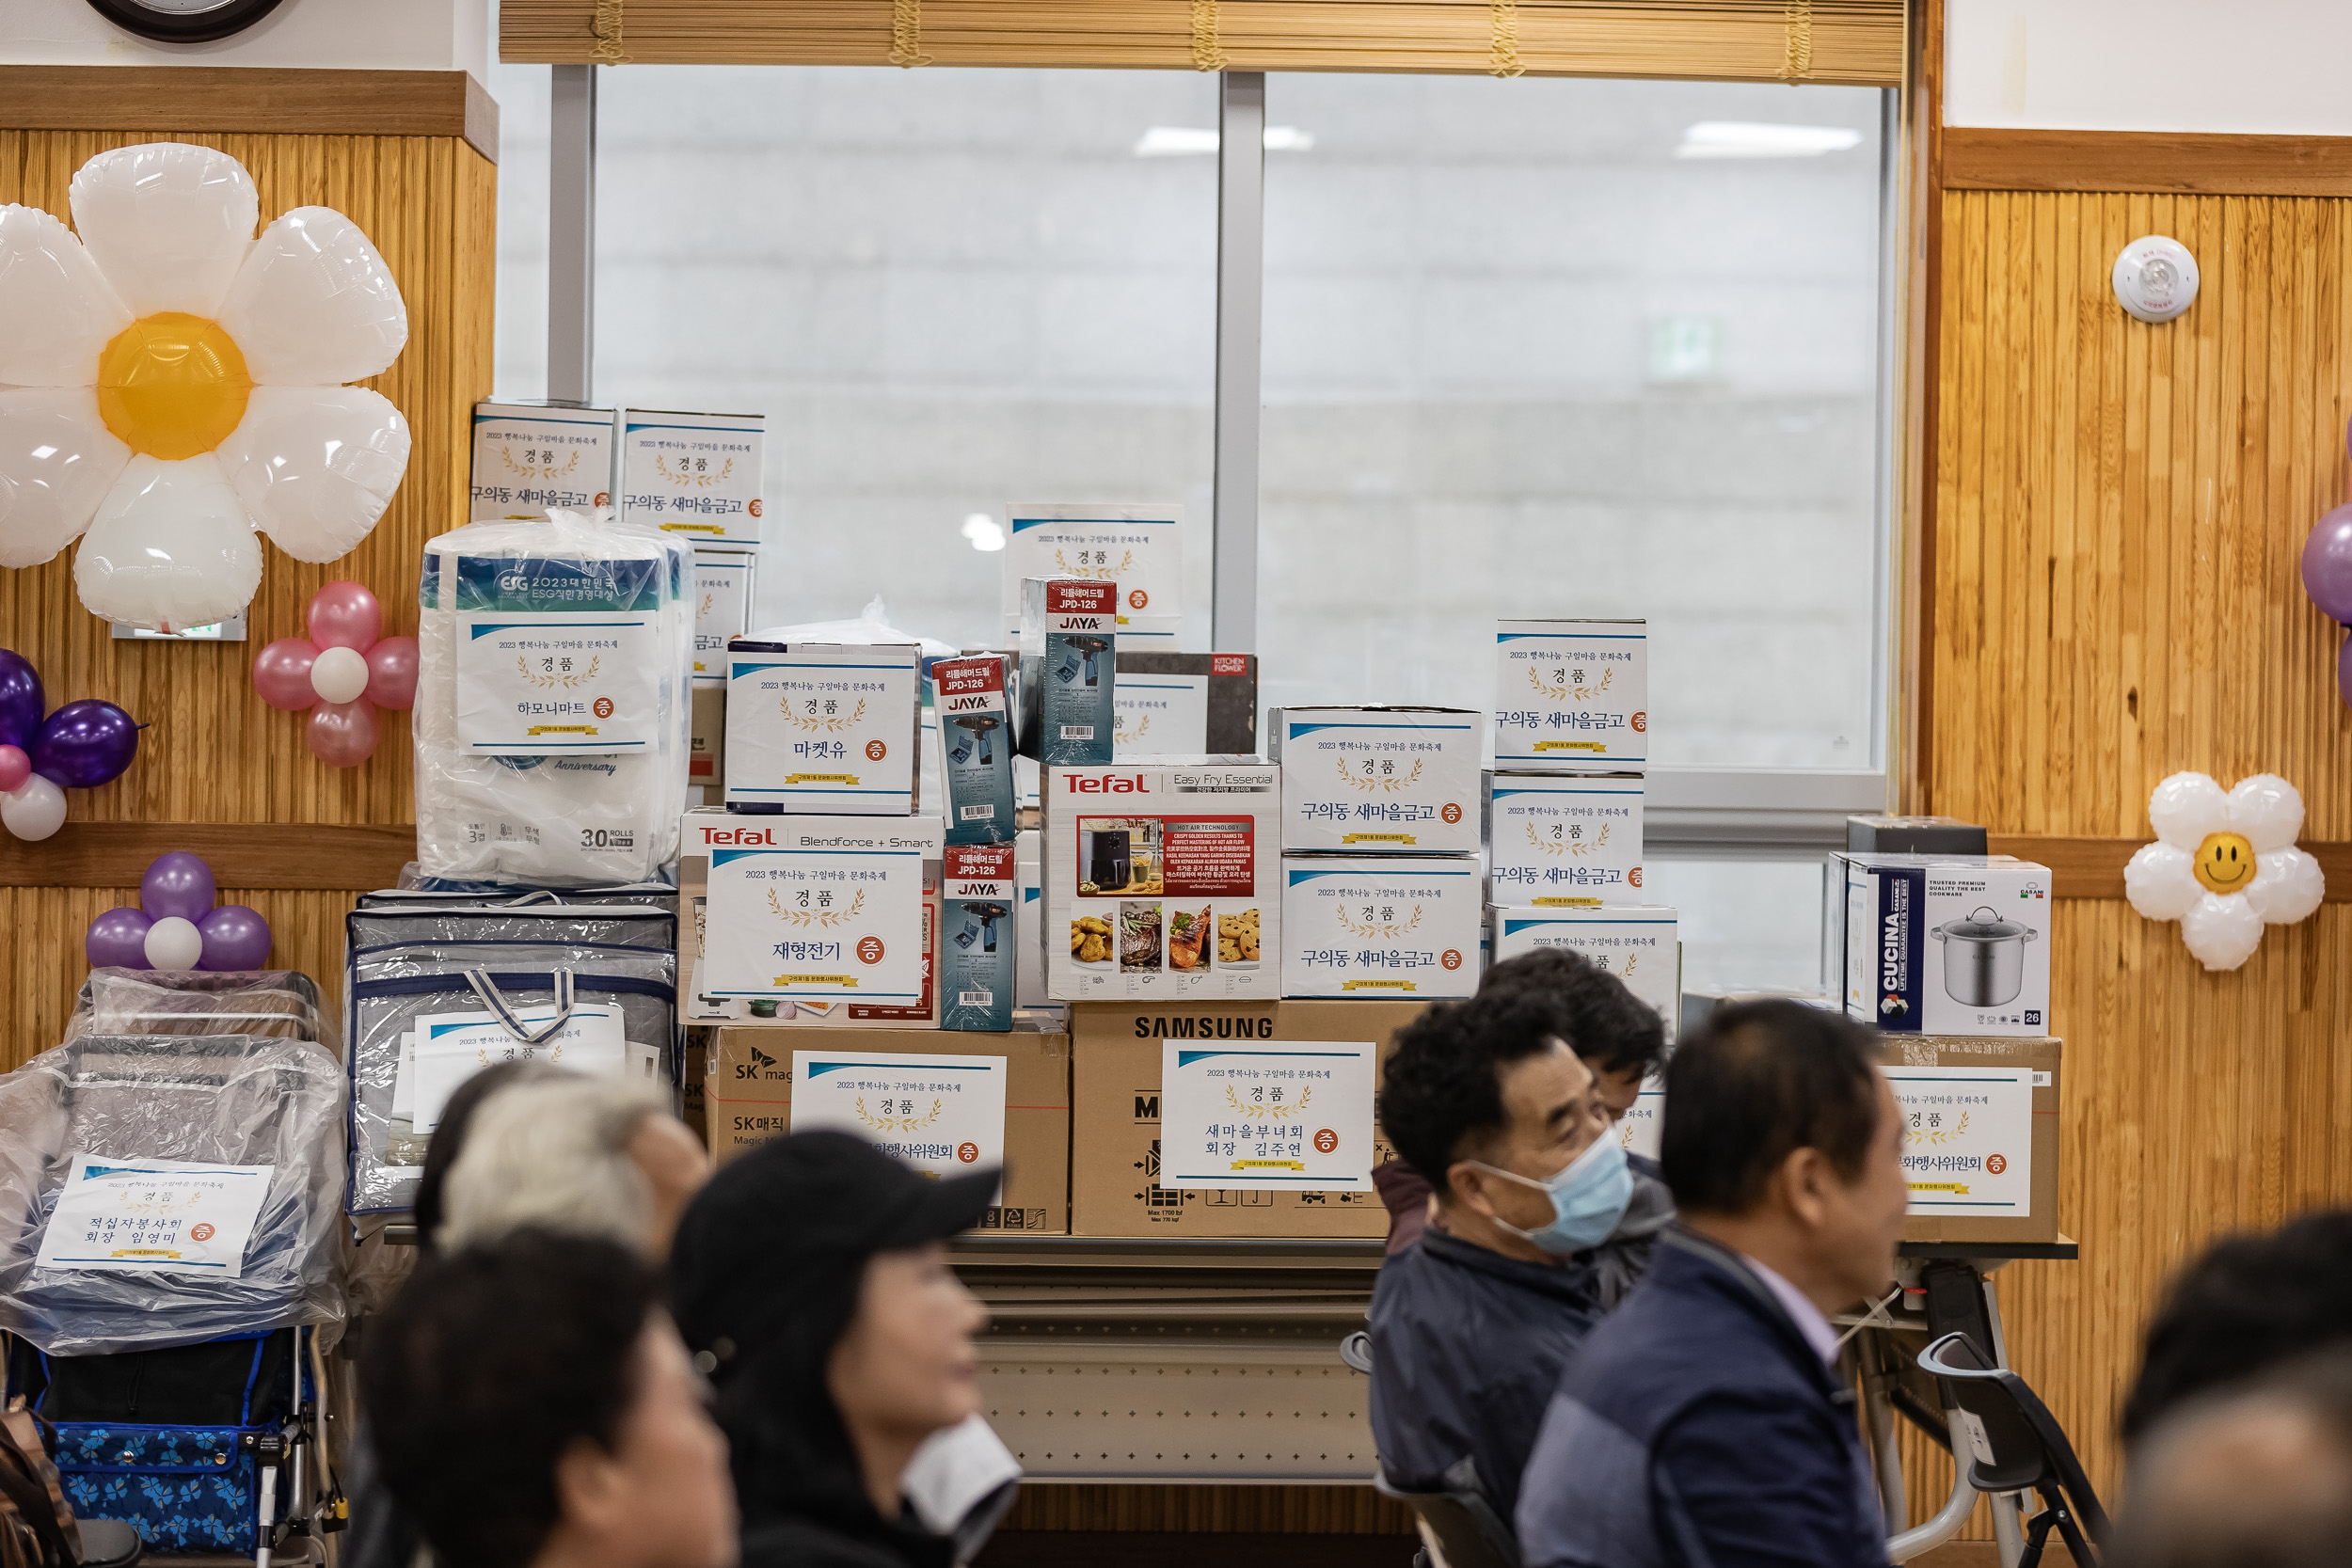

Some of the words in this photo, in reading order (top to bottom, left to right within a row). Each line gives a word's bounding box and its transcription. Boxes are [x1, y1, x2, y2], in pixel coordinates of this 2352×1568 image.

[524, 449, 554, 464] 경품
[678, 457, 707, 471] 경품
[471, 485, 513, 504] 구의동
[516, 488, 589, 507] 새마을금고
[623, 494, 667, 511] 구의동
[671, 497, 742, 514] 새마을금고
[1078, 551, 1106, 564] 경품
[501, 576, 528, 591] ESG
[1059, 600, 1097, 609] JPD-126
[1133, 593, 1145, 606] 증
[1060, 618, 1103, 629] JAYA
[519, 641, 549, 649] 행복나눔
[553, 641, 583, 649] 구일마을
[586, 641, 618, 649] 문화축제
[1530, 651, 1562, 659] 행복나눔
[1565, 652, 1597, 660] 구일마을
[1599, 652, 1631, 661] 문화축제
[541, 657, 574, 672] 경품
[1552, 668, 1585, 683] 경품
[782, 682, 814, 690] 행복나눔
[818, 683, 850, 691] 구일마을
[852, 683, 885, 691] 문화축제
[946, 680, 983, 690] JPD-126
[517, 702, 586, 715] 하모니마트
[596, 701, 612, 715] 증
[804, 700, 838, 714] 경품
[948, 697, 992, 711] JAYA
[1495, 711, 1541, 729] 구의동
[1545, 711, 1625, 730] 새마을금고
[794, 741, 847, 759] 마켓유
[869, 744, 882, 758] 증
[1339, 742, 1371, 751] 행복나눔
[1409, 743, 1441, 752] 문화축제
[555, 760, 616, 775] Anniversary
[1362, 759, 1395, 774] 경품
[1063, 774, 1150, 793] Tefal
[1174, 775, 1200, 785] Easy
[1204, 775, 1222, 785] Fry
[1226, 775, 1272, 784] Essential
[1301, 802, 1350, 820] 구의동
[1354, 803, 1435, 821] 새마을금고
[1444, 806, 1458, 820] 증
[1528, 807, 1560, 816] 행복나눔
[1597, 808, 1629, 816] 문화축제
[581, 829, 608, 847] 30
[699, 828, 777, 846] Tefal
[1550, 824, 1582, 839] 경품
[801, 836, 873, 847] Blendforce
[890, 838, 933, 848] Smart
[745, 870, 765, 879] 2023
[769, 870, 805, 879] 행복나눔
[809, 871, 846, 880] 구일마을
[850, 871, 886, 881] 문화축제
[958, 866, 995, 875] JPD-126
[1492, 867, 1539, 884] 구의동
[1543, 867, 1622, 885] 새마을금고
[959, 884, 1001, 895] JAYA
[1338, 889, 1371, 897] 행복나눔
[1409, 890, 1441, 898] 문화축제
[795, 890, 834, 907] 경품
[1361, 906, 1394, 921] 경품
[1554, 938, 1585, 946] 행복나눔
[1590, 938, 1621, 946] 구일마을
[1624, 938, 1655, 946] 문화축제
[772, 942, 841, 960] 재형전기
[862, 941, 880, 958] 증
[1883, 912, 1899, 990] CUCINA
[1301, 950, 1350, 967] 구의동
[1354, 950, 1435, 968] 새마을금고
[1444, 953, 1458, 967] 증
[2026, 1014, 2039, 1022] 26
[1136, 1017, 1272, 1038] SAMSUNG
[479, 1035, 511, 1045] 행복나눔
[736, 1065, 758, 1080] SK
[1228, 1069, 1261, 1078] 행복나눔
[1263, 1069, 1295, 1079] 구일마을
[1298, 1069, 1330, 1079] 문화축제
[837, 1081, 854, 1089] 2023
[858, 1081, 890, 1091] 행복나눔
[894, 1082, 925, 1092] 구일마을
[929, 1083, 961, 1092] 문화축제
[1250, 1086, 1284, 1101] 경품
[881, 1099, 914, 1115] 경품
[1922, 1096, 1953, 1104] 구일마을
[1956, 1096, 1988, 1104] 문화축제
[734, 1117, 784, 1131] SK매직
[1909, 1112, 1942, 1127] 경품
[1205, 1124, 1303, 1139] 새마을부녀회
[1318, 1132, 1334, 1149] 증
[961, 1146, 975, 1160] 증
[1205, 1142, 1237, 1157] 회장
[1255, 1142, 1301, 1157] 김주연
[1990, 1157, 2003, 1171] 증
[88, 1217, 183, 1230] 적십자봉사회
[196, 1225, 209, 1239] 증
[85, 1232, 115, 1243] 회장
[132, 1233, 176, 1244] 임영미
